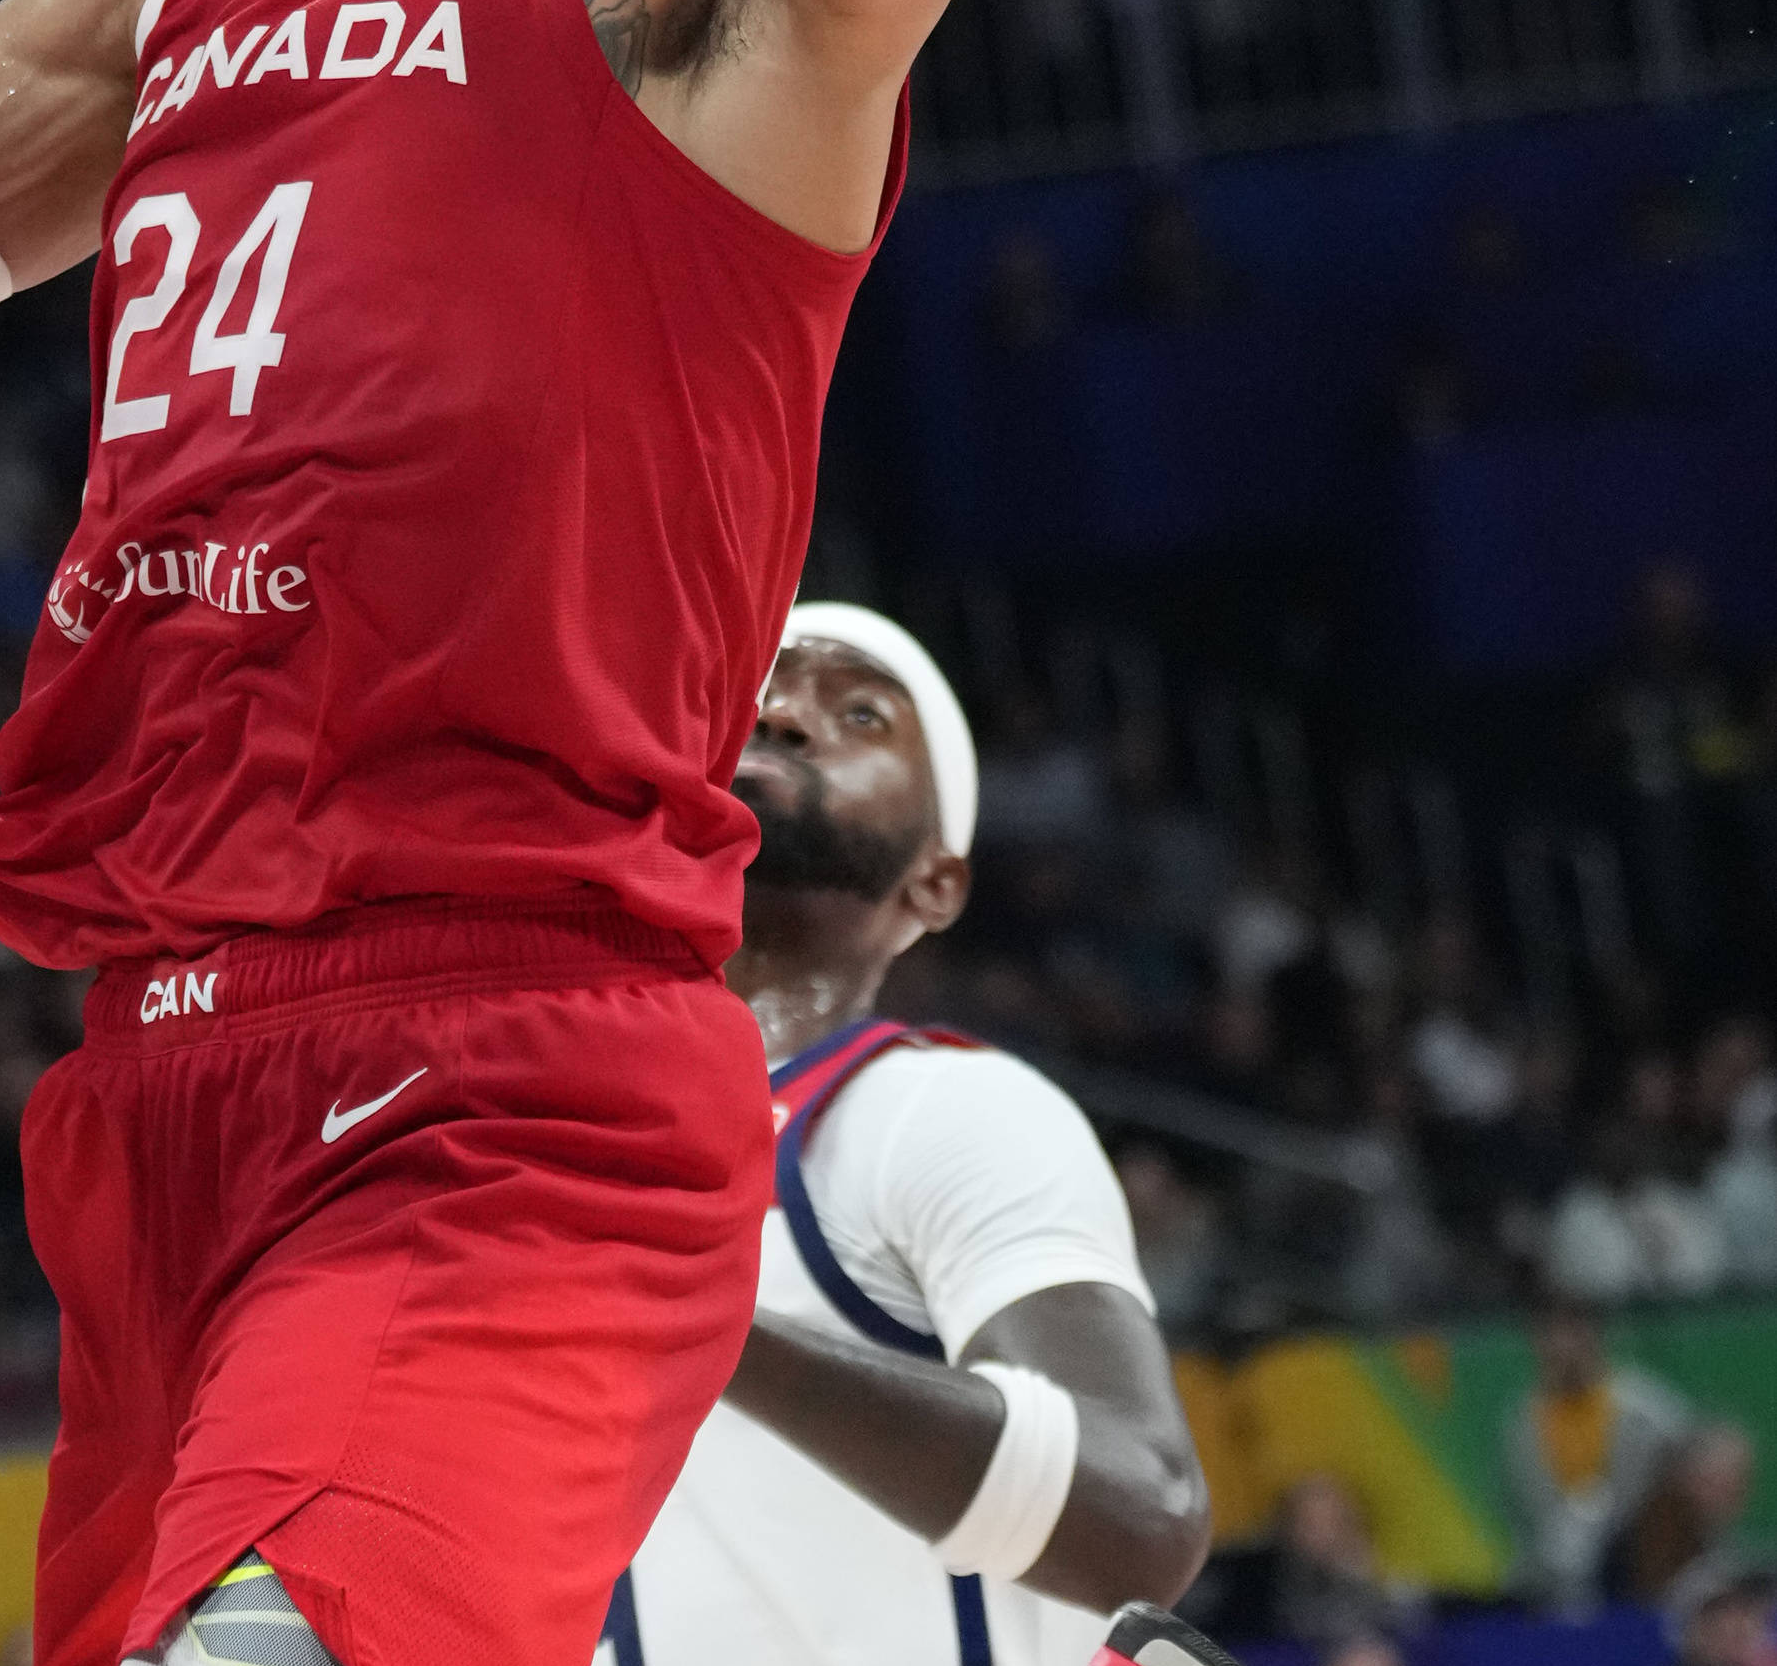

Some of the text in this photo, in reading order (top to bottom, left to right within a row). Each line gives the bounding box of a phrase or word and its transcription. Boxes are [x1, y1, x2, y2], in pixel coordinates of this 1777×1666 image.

[127, 0, 468, 144] CANADA
[101, 181, 314, 443] 24
[140, 972, 218, 1024] CAN
